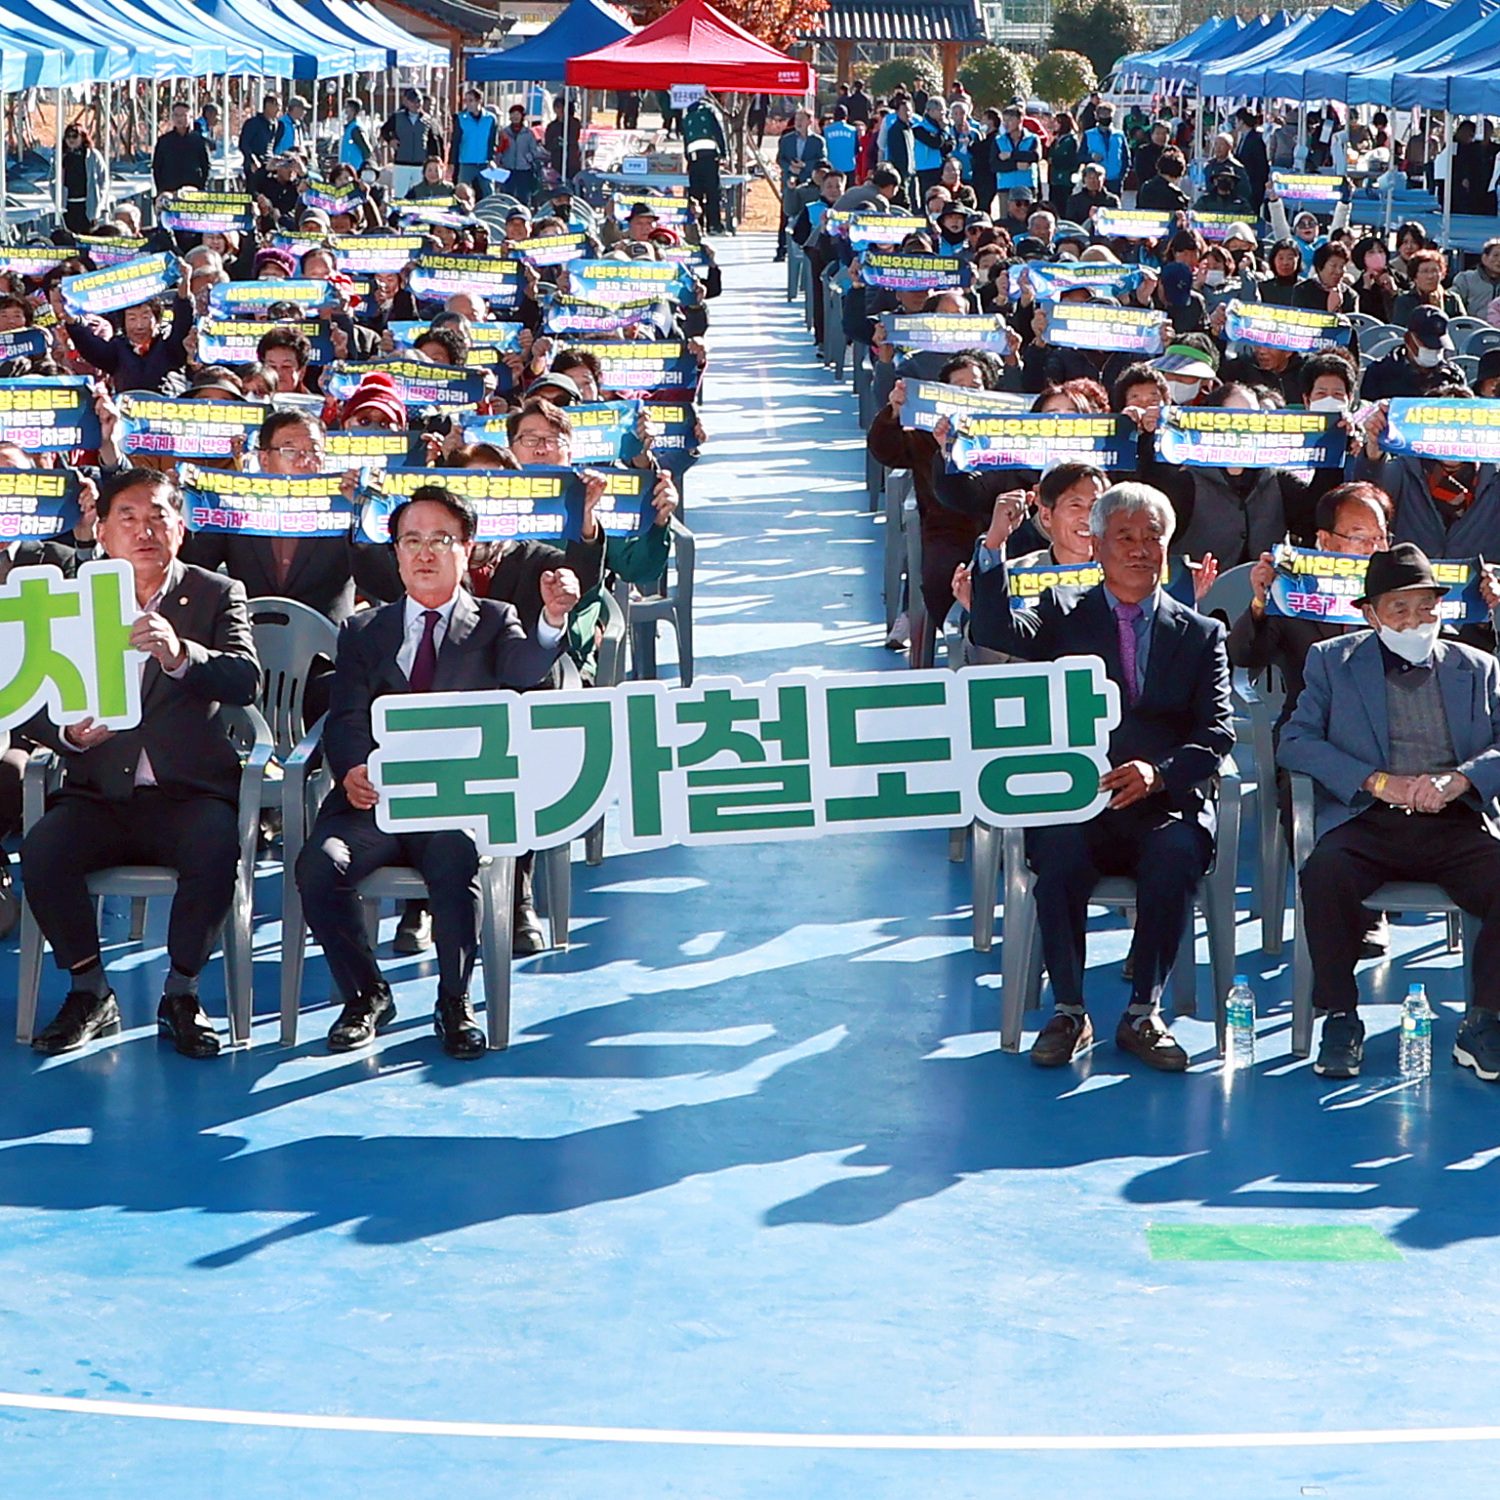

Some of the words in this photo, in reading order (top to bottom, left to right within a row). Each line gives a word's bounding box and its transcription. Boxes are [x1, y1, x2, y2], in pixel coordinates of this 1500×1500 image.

[131, 404, 264, 422] 사천우주항공철도!
[150, 422, 182, 432] 제5차
[185, 423, 244, 435] 국가철도망
[1179, 414, 1326, 432] 사천우주항공철도!
[127, 435, 198, 451] 구축계획에
[1200, 433, 1238, 446] 제5차
[1242, 433, 1304, 447] 국가철도망
[1422, 429, 1459, 442] 제5차
[1175, 446, 1254, 462] 구축계획에
[1257, 448, 1325, 462] 반영하라!
[1412, 443, 1476, 455] 구축계획에
[195, 476, 342, 496] 사천우주항공철도
[474, 501, 534, 513] 가철도망
[381, 668, 1107, 845] 국가철도망
